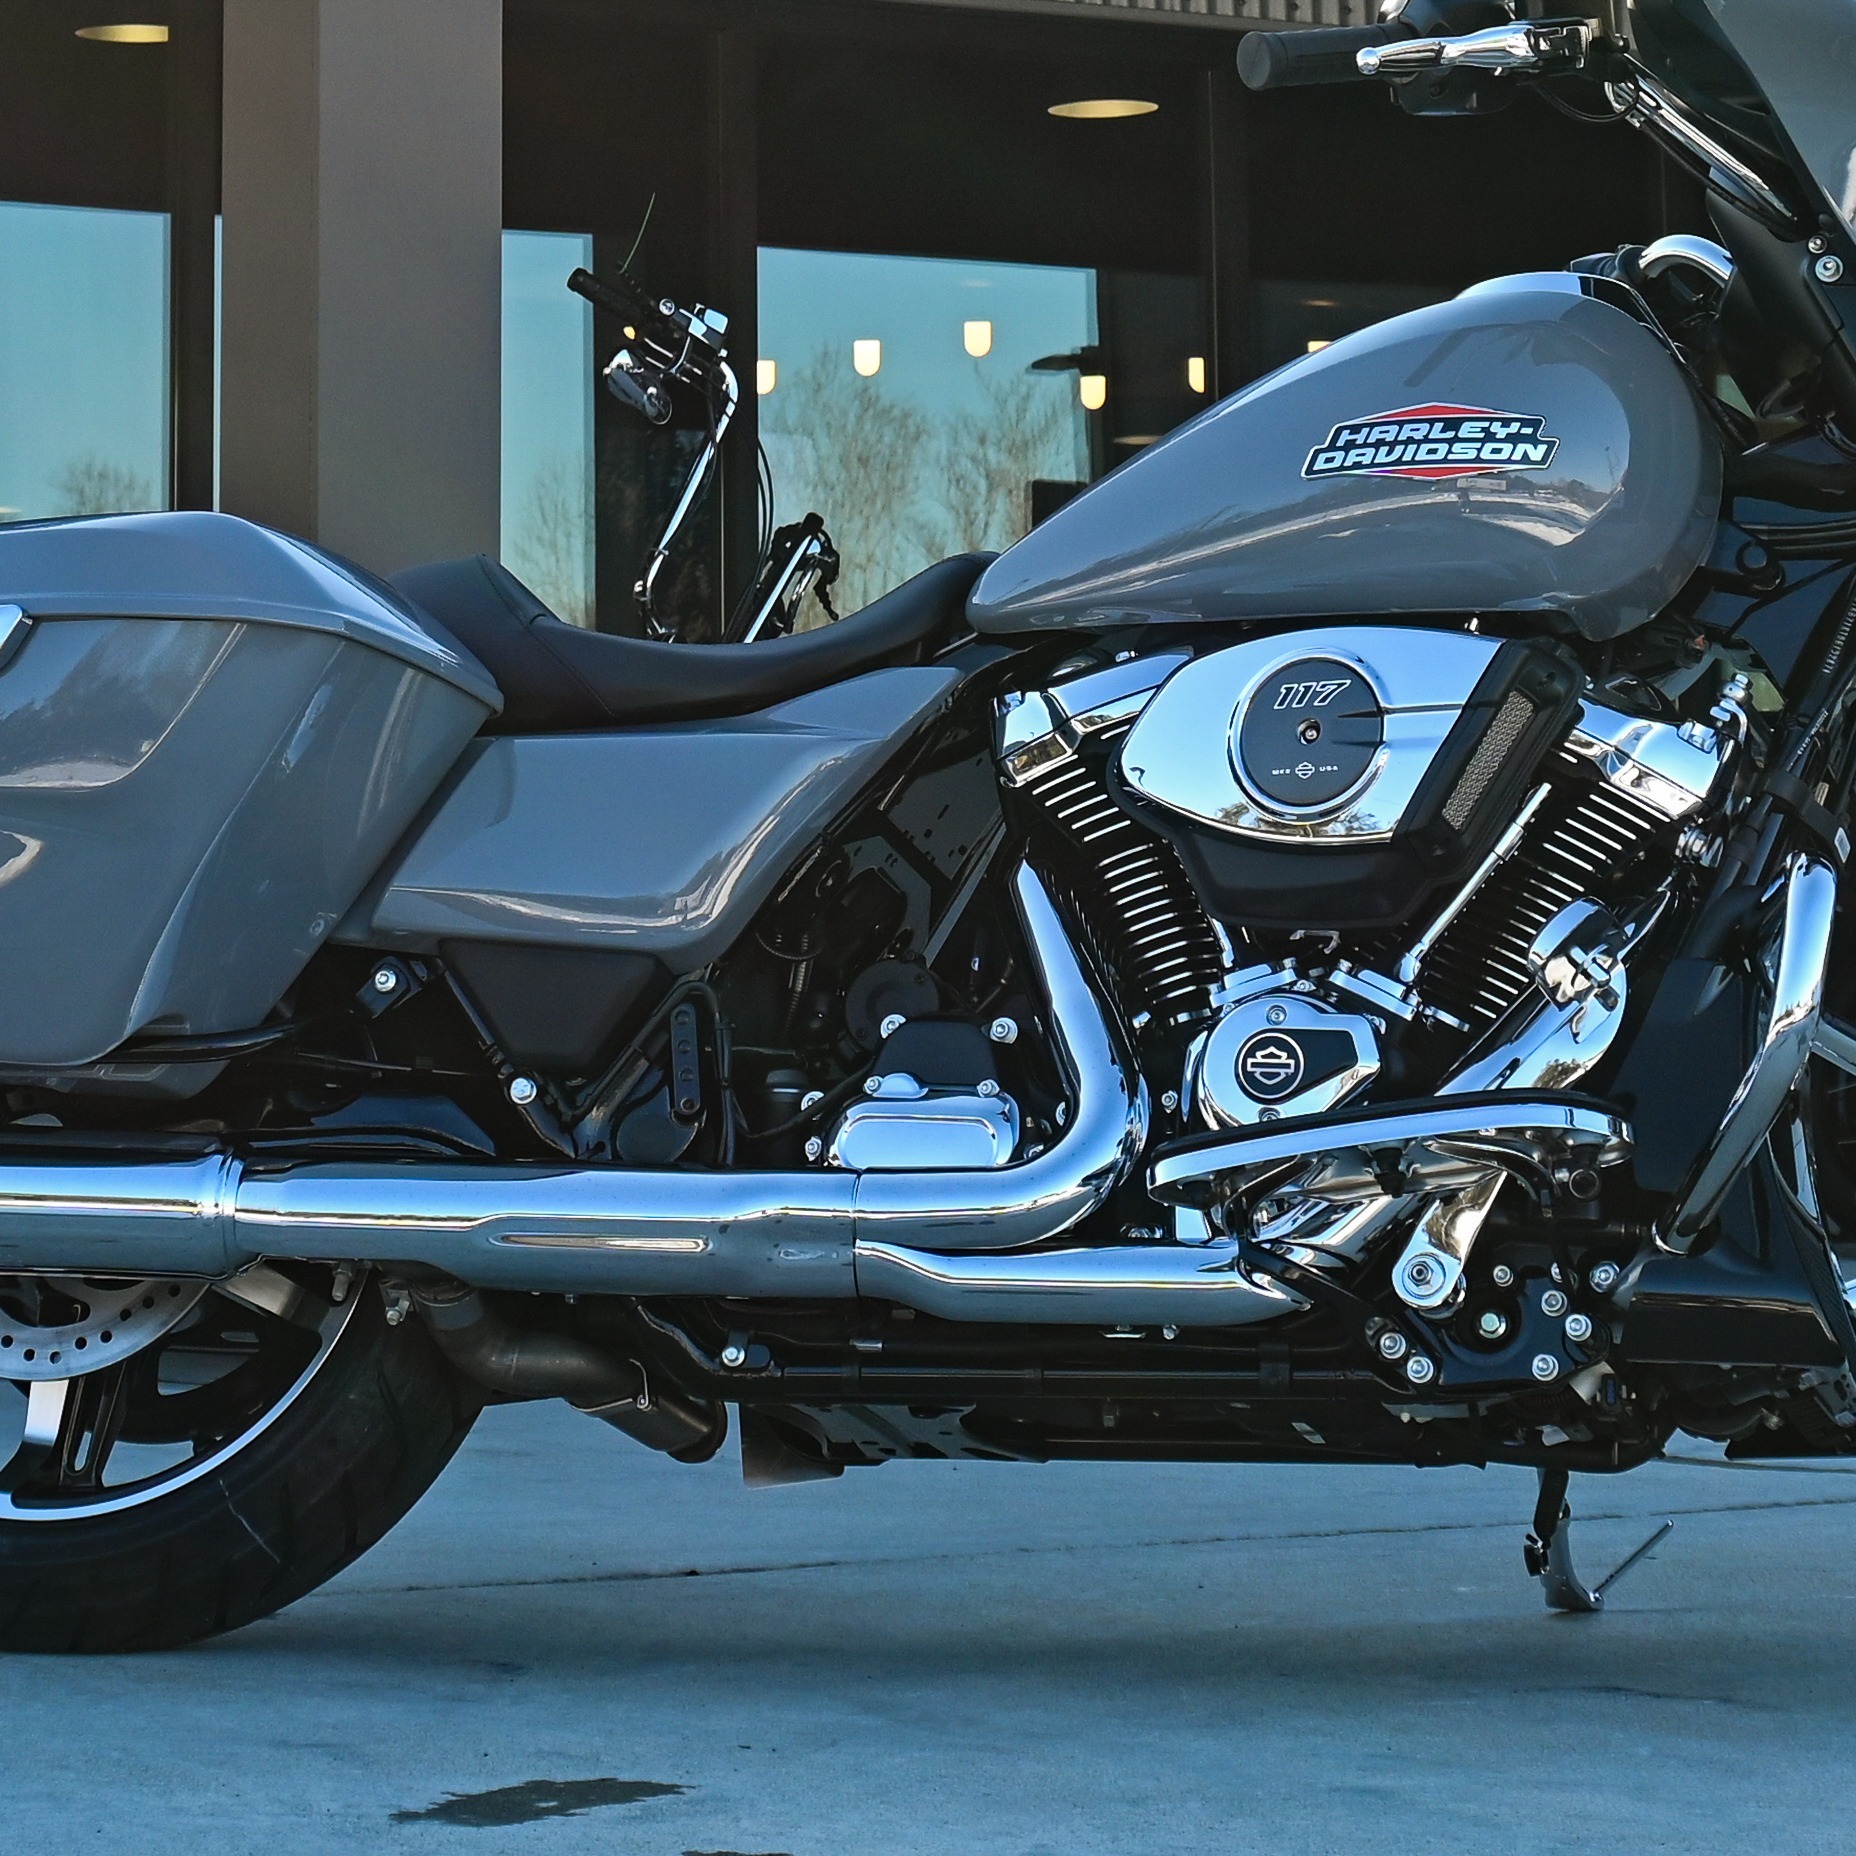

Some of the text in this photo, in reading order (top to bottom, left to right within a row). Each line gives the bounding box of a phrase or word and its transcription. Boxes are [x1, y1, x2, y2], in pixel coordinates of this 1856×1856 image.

[1336, 421, 1534, 447] HARLEY-
[1313, 442, 1549, 472] DAVIDSON
[1273, 679, 1351, 709] 117
